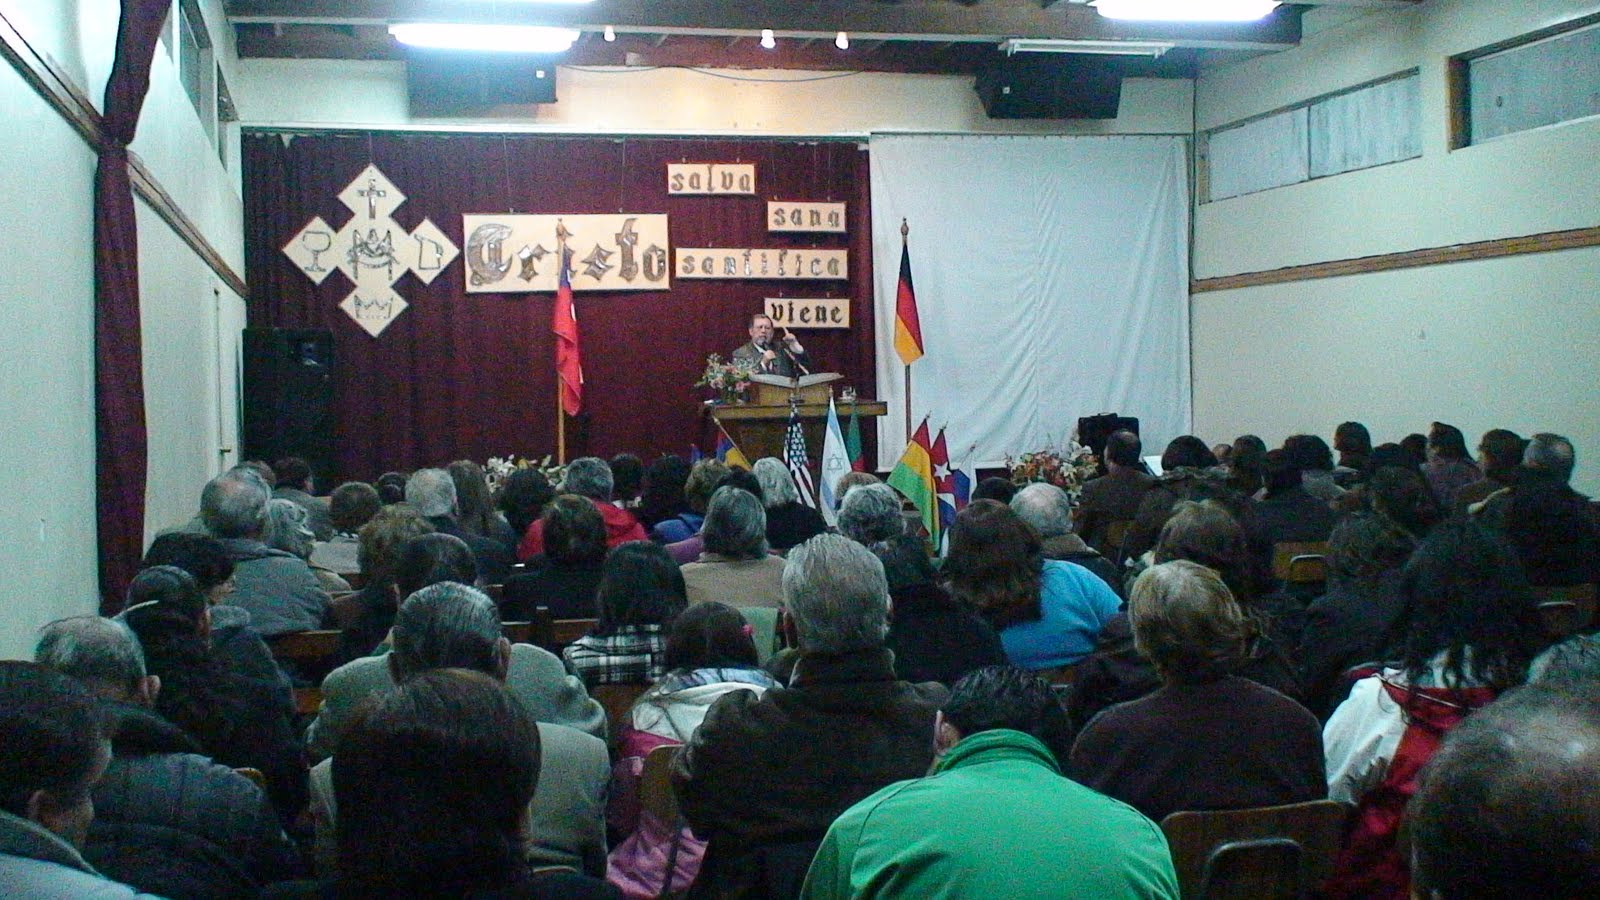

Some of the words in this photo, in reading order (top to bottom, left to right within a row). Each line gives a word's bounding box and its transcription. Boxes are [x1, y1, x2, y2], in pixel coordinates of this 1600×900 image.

[671, 164, 751, 192] salva
[773, 207, 840, 227] sana
[682, 249, 840, 276] santifica
[771, 300, 843, 324] viene
